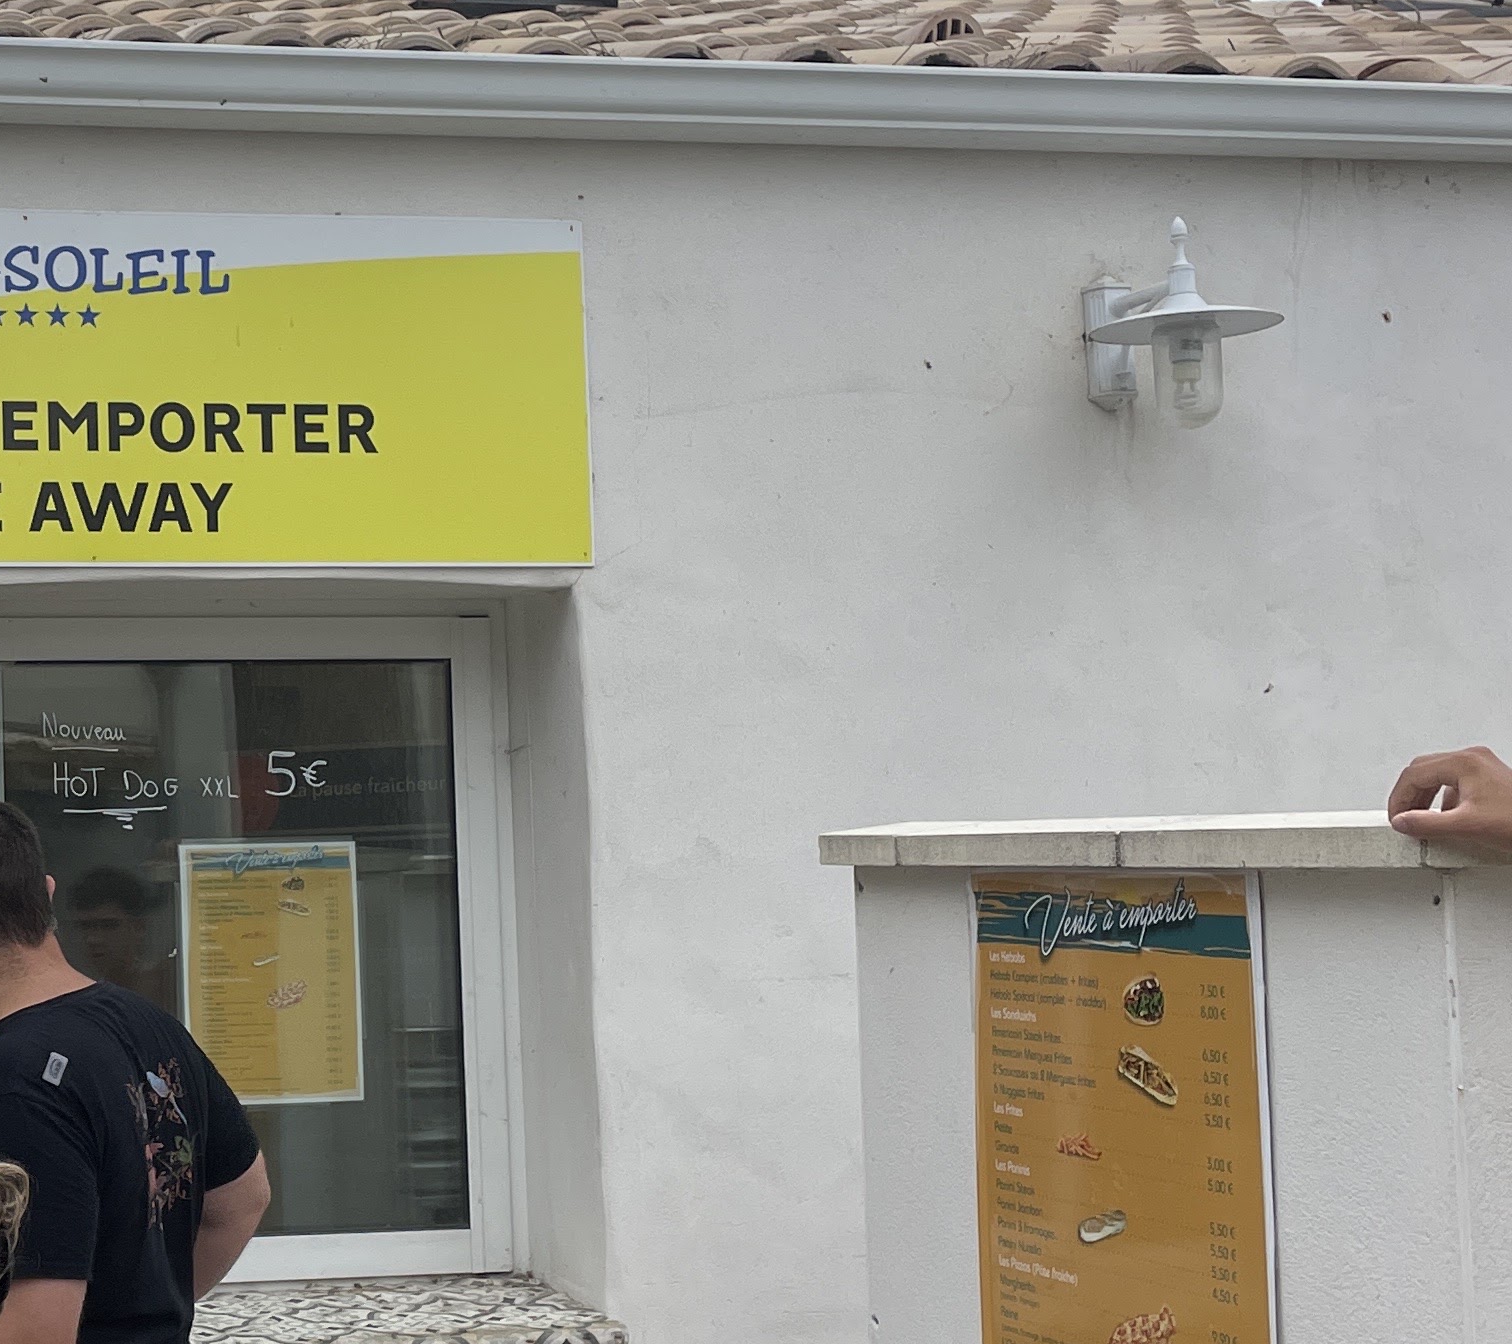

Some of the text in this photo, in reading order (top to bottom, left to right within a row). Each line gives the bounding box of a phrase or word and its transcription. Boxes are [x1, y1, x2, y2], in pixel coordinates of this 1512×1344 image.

[2, 401, 379, 454] EMPORTER
[29, 482, 235, 534] AWAY
[42, 712, 126, 741] Nouveau
[200, 776, 239, 799] XXL
[313, 783, 362, 801] pause
[1025, 876, 1197, 956] Vente à emporter
